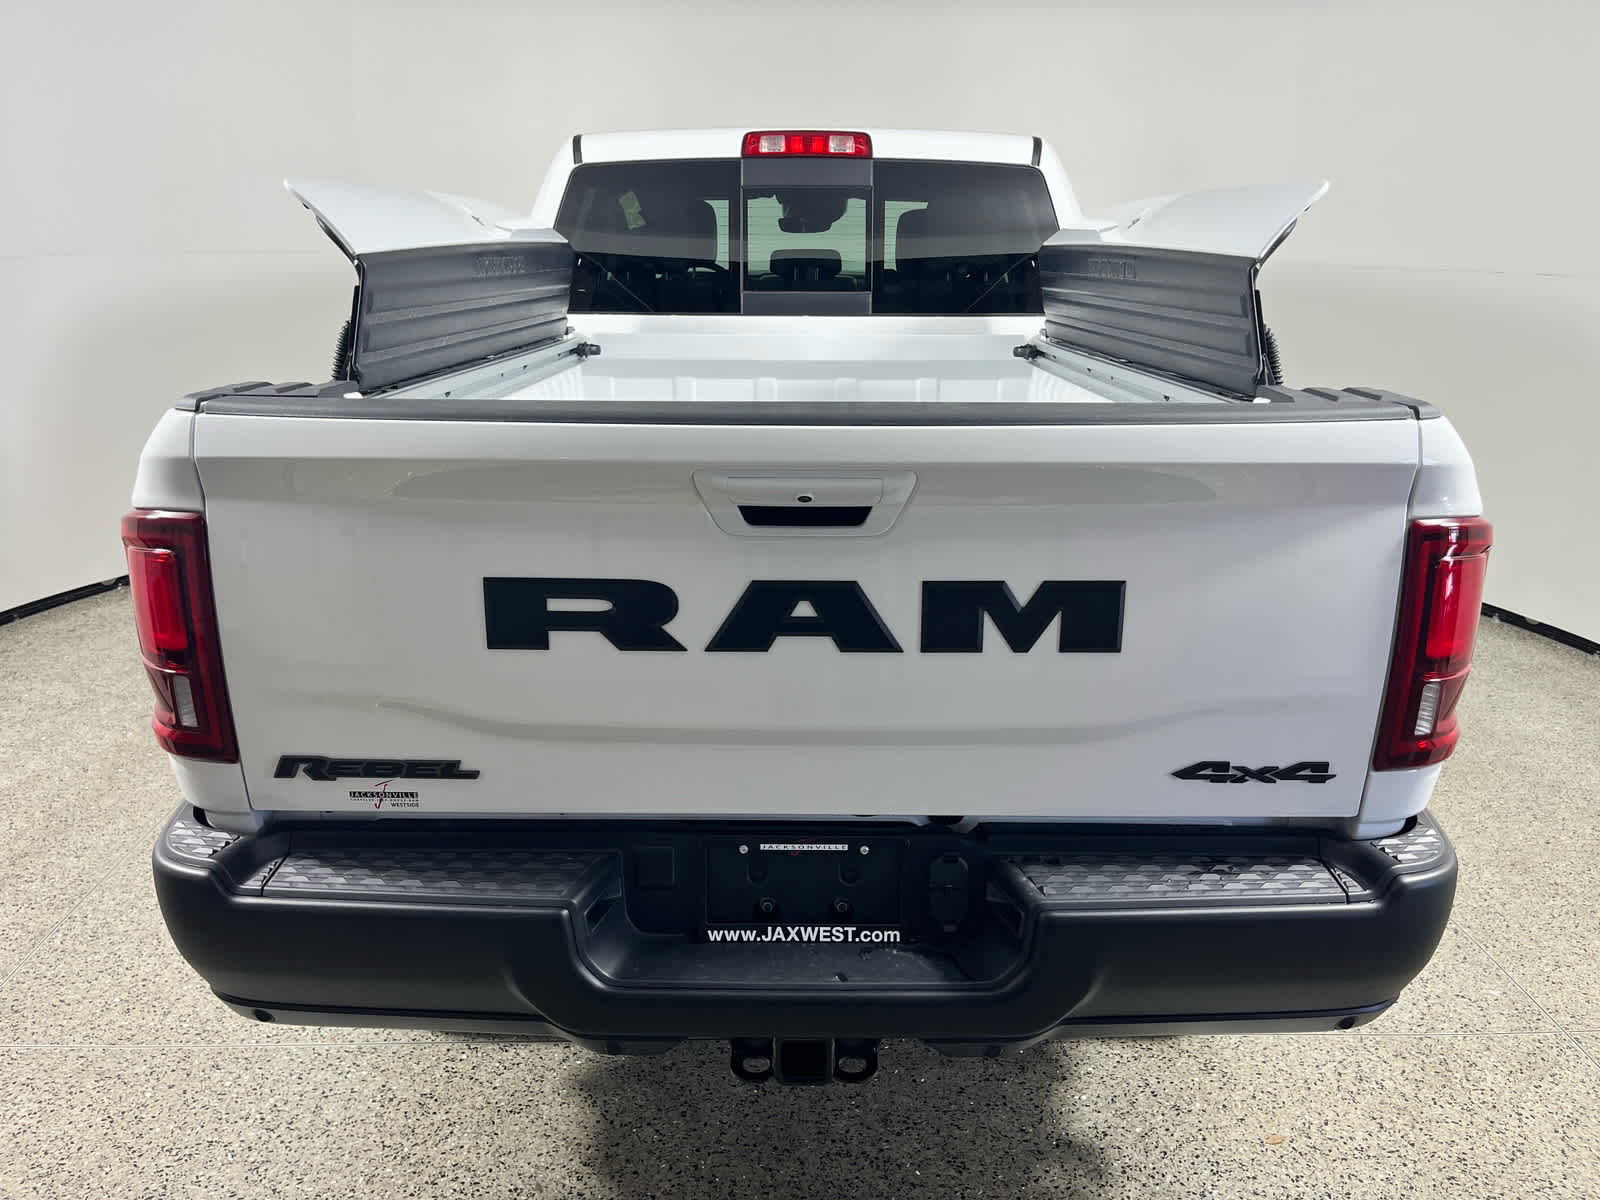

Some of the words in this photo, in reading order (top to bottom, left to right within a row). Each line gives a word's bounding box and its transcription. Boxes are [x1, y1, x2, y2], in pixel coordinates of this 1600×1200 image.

[483, 577, 1126, 653] RAM
[273, 755, 480, 781] REBEL
[760, 843, 849, 851] JACKSONVILLE
[707, 926, 901, 943] www.JAXWEST.com
